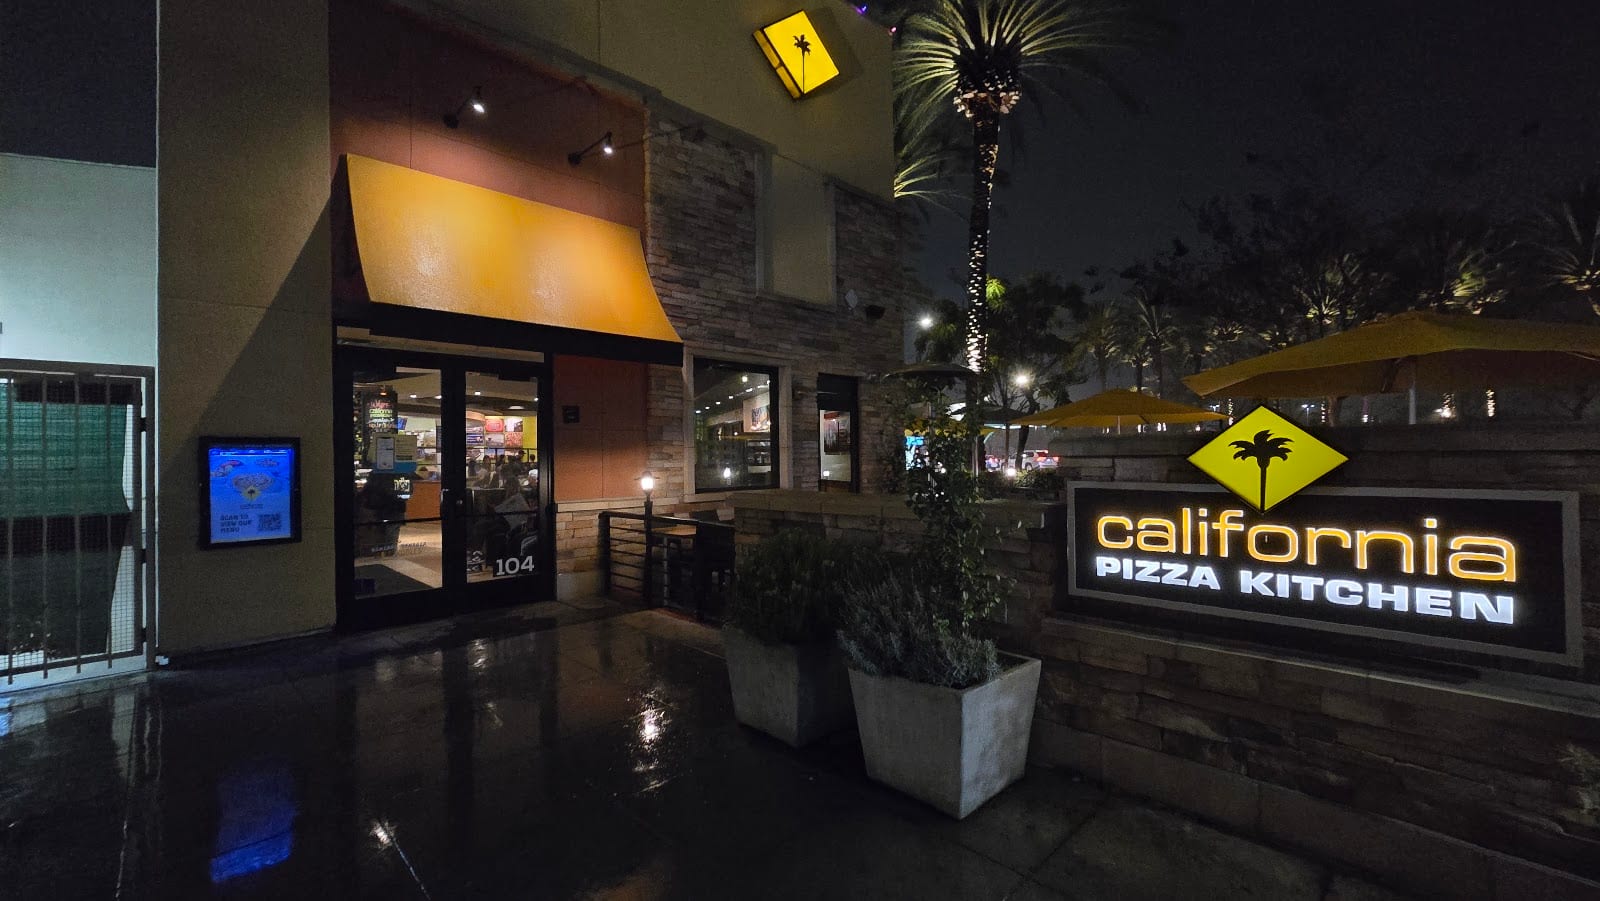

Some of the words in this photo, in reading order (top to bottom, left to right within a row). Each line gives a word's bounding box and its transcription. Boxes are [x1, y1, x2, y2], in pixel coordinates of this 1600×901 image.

[496, 555, 535, 576] 104
[1097, 508, 1517, 582] california
[1096, 556, 1221, 591] PIZZA
[1239, 570, 1515, 625] KITCHEN
